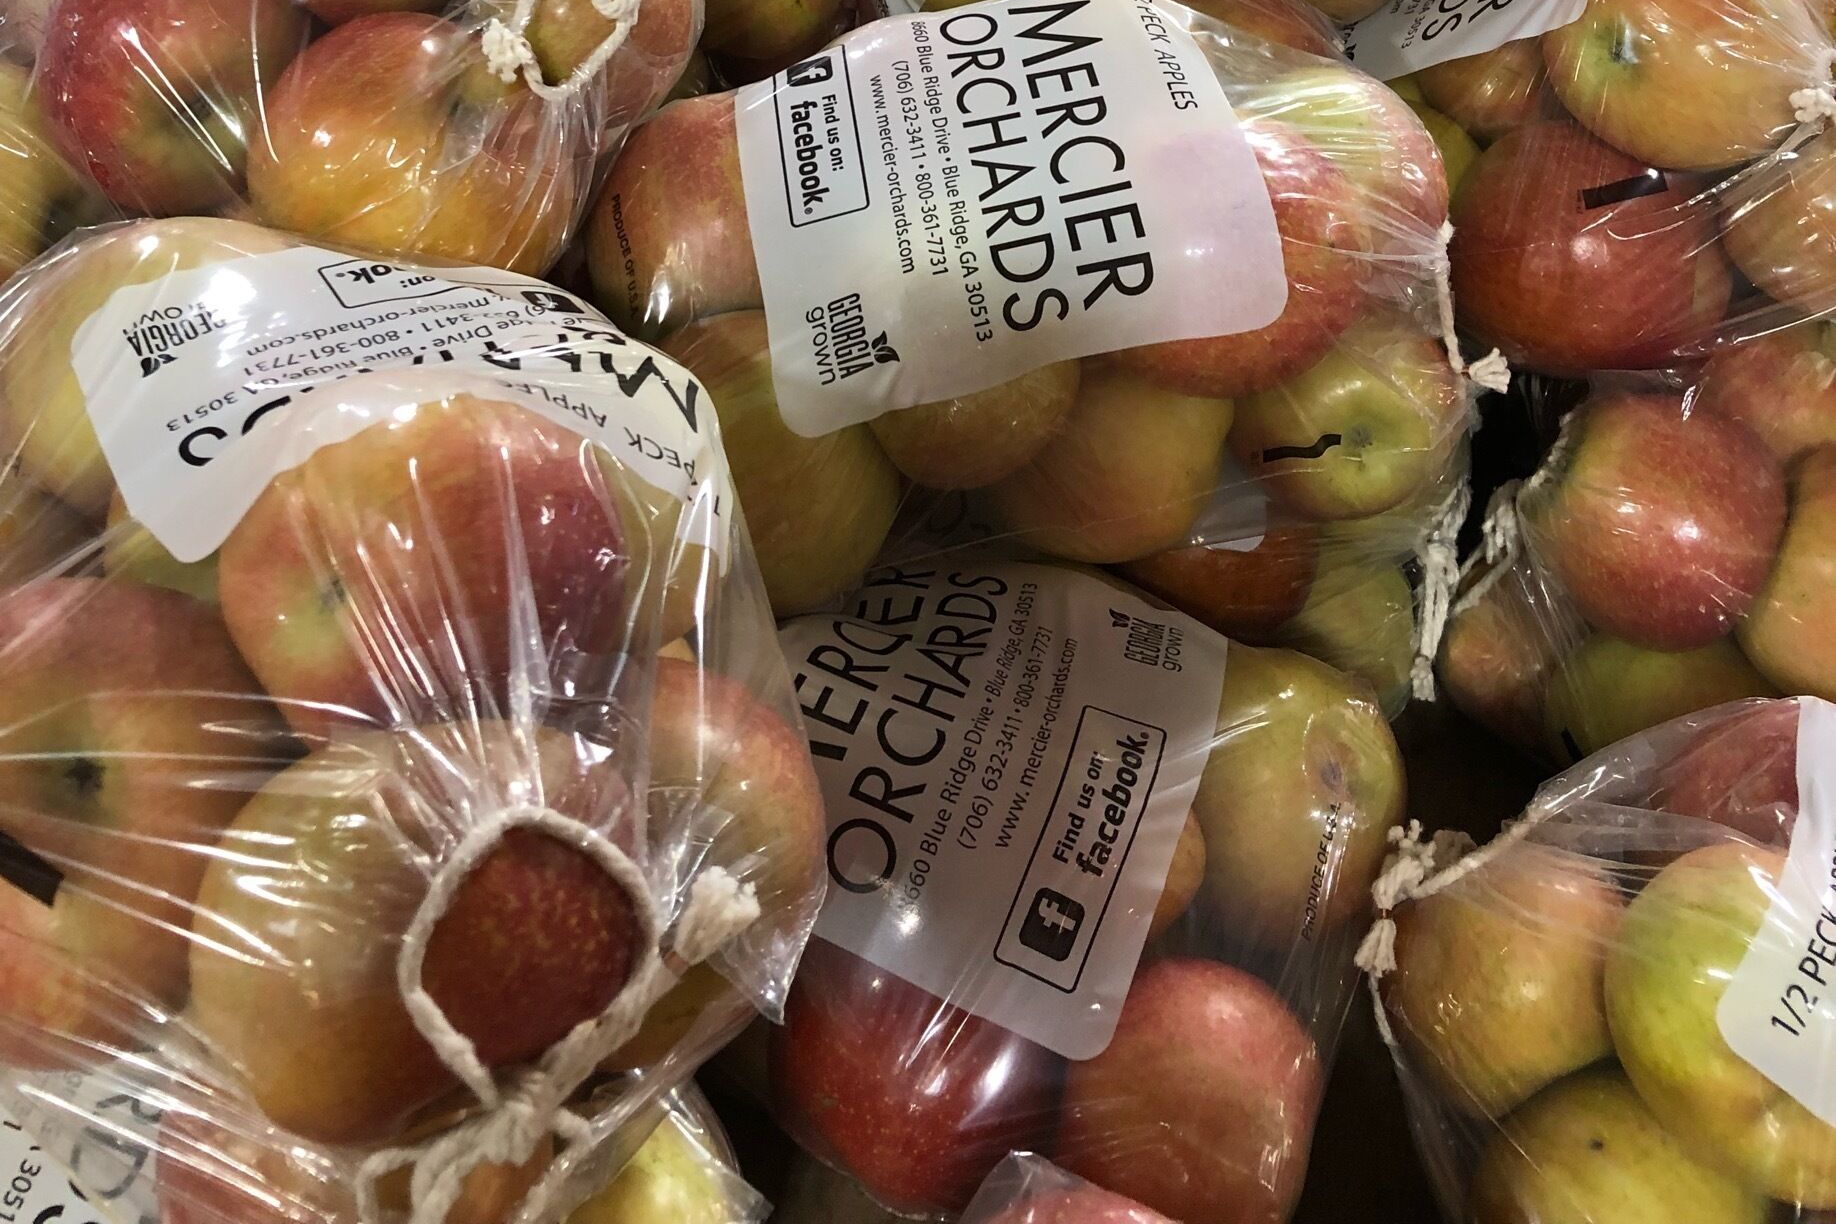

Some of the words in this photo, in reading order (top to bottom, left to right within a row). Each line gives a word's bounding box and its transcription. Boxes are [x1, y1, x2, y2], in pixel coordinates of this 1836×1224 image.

[1140, 4, 1171, 44] PECK
[892, 60, 912, 94] (706)
[916, 43, 934, 73] Blue
[1153, 47, 1199, 111] APPLES
[821, 93, 840, 125] Find
[923, 75, 943, 115] Ridge
[826, 126, 841, 145] us
[899, 97, 925, 161] 632-3411
[931, 116, 950, 155] Drive
[829, 147, 845, 172] on:
[869, 74, 916, 274] www.mercier-orchards.com
[939, 12, 1070, 332] ORCHARDS
[1007, 0, 1154, 311] MERCIER
[942, 165, 961, 198] Blue
[611, 192, 632, 258] PRODUCE
[915, 172, 949, 276] 800-361-7731
[948, 199, 970, 250] Ridge,
[959, 251, 979, 278] GA
[432, 324, 493, 349] Drive
[827, 292, 875, 380] GEORGIA
[965, 281, 994, 343] 30513
[243, 329, 401, 377] 800-361-7731
[805, 306, 836, 386] grown
[166, 390, 240, 433] 30513
[1015, 581, 1039, 618] 30513
[997, 634, 1025, 670] Ridge,
[1009, 617, 1027, 639] GA
[1123, 617, 1167, 668] GEORGIA
[1162, 626, 1185, 673] grown
[987, 665, 1009, 699] Blue
[826, 571, 1009, 895] ORCHARDS
[955, 794, 994, 850] (706)
[981, 713, 1025, 794] 632-3411
[1015, 624, 1054, 710] 800-361-7731
[972, 705, 996, 746] Drive
[994, 636, 1079, 850] www.mercier-orchards.com
[939, 745, 978, 807] Ridge
[1052, 814, 1087, 866] Find
[1077, 784, 1096, 812] us
[1087, 749, 1108, 786] on:
[920, 810, 953, 857] Blue
[897, 857, 932, 912] 660
[1301, 864, 1326, 942] PRODUCE
[1771, 983, 1819, 1037] 1/2
[0, 1158, 42, 1223] 3051
